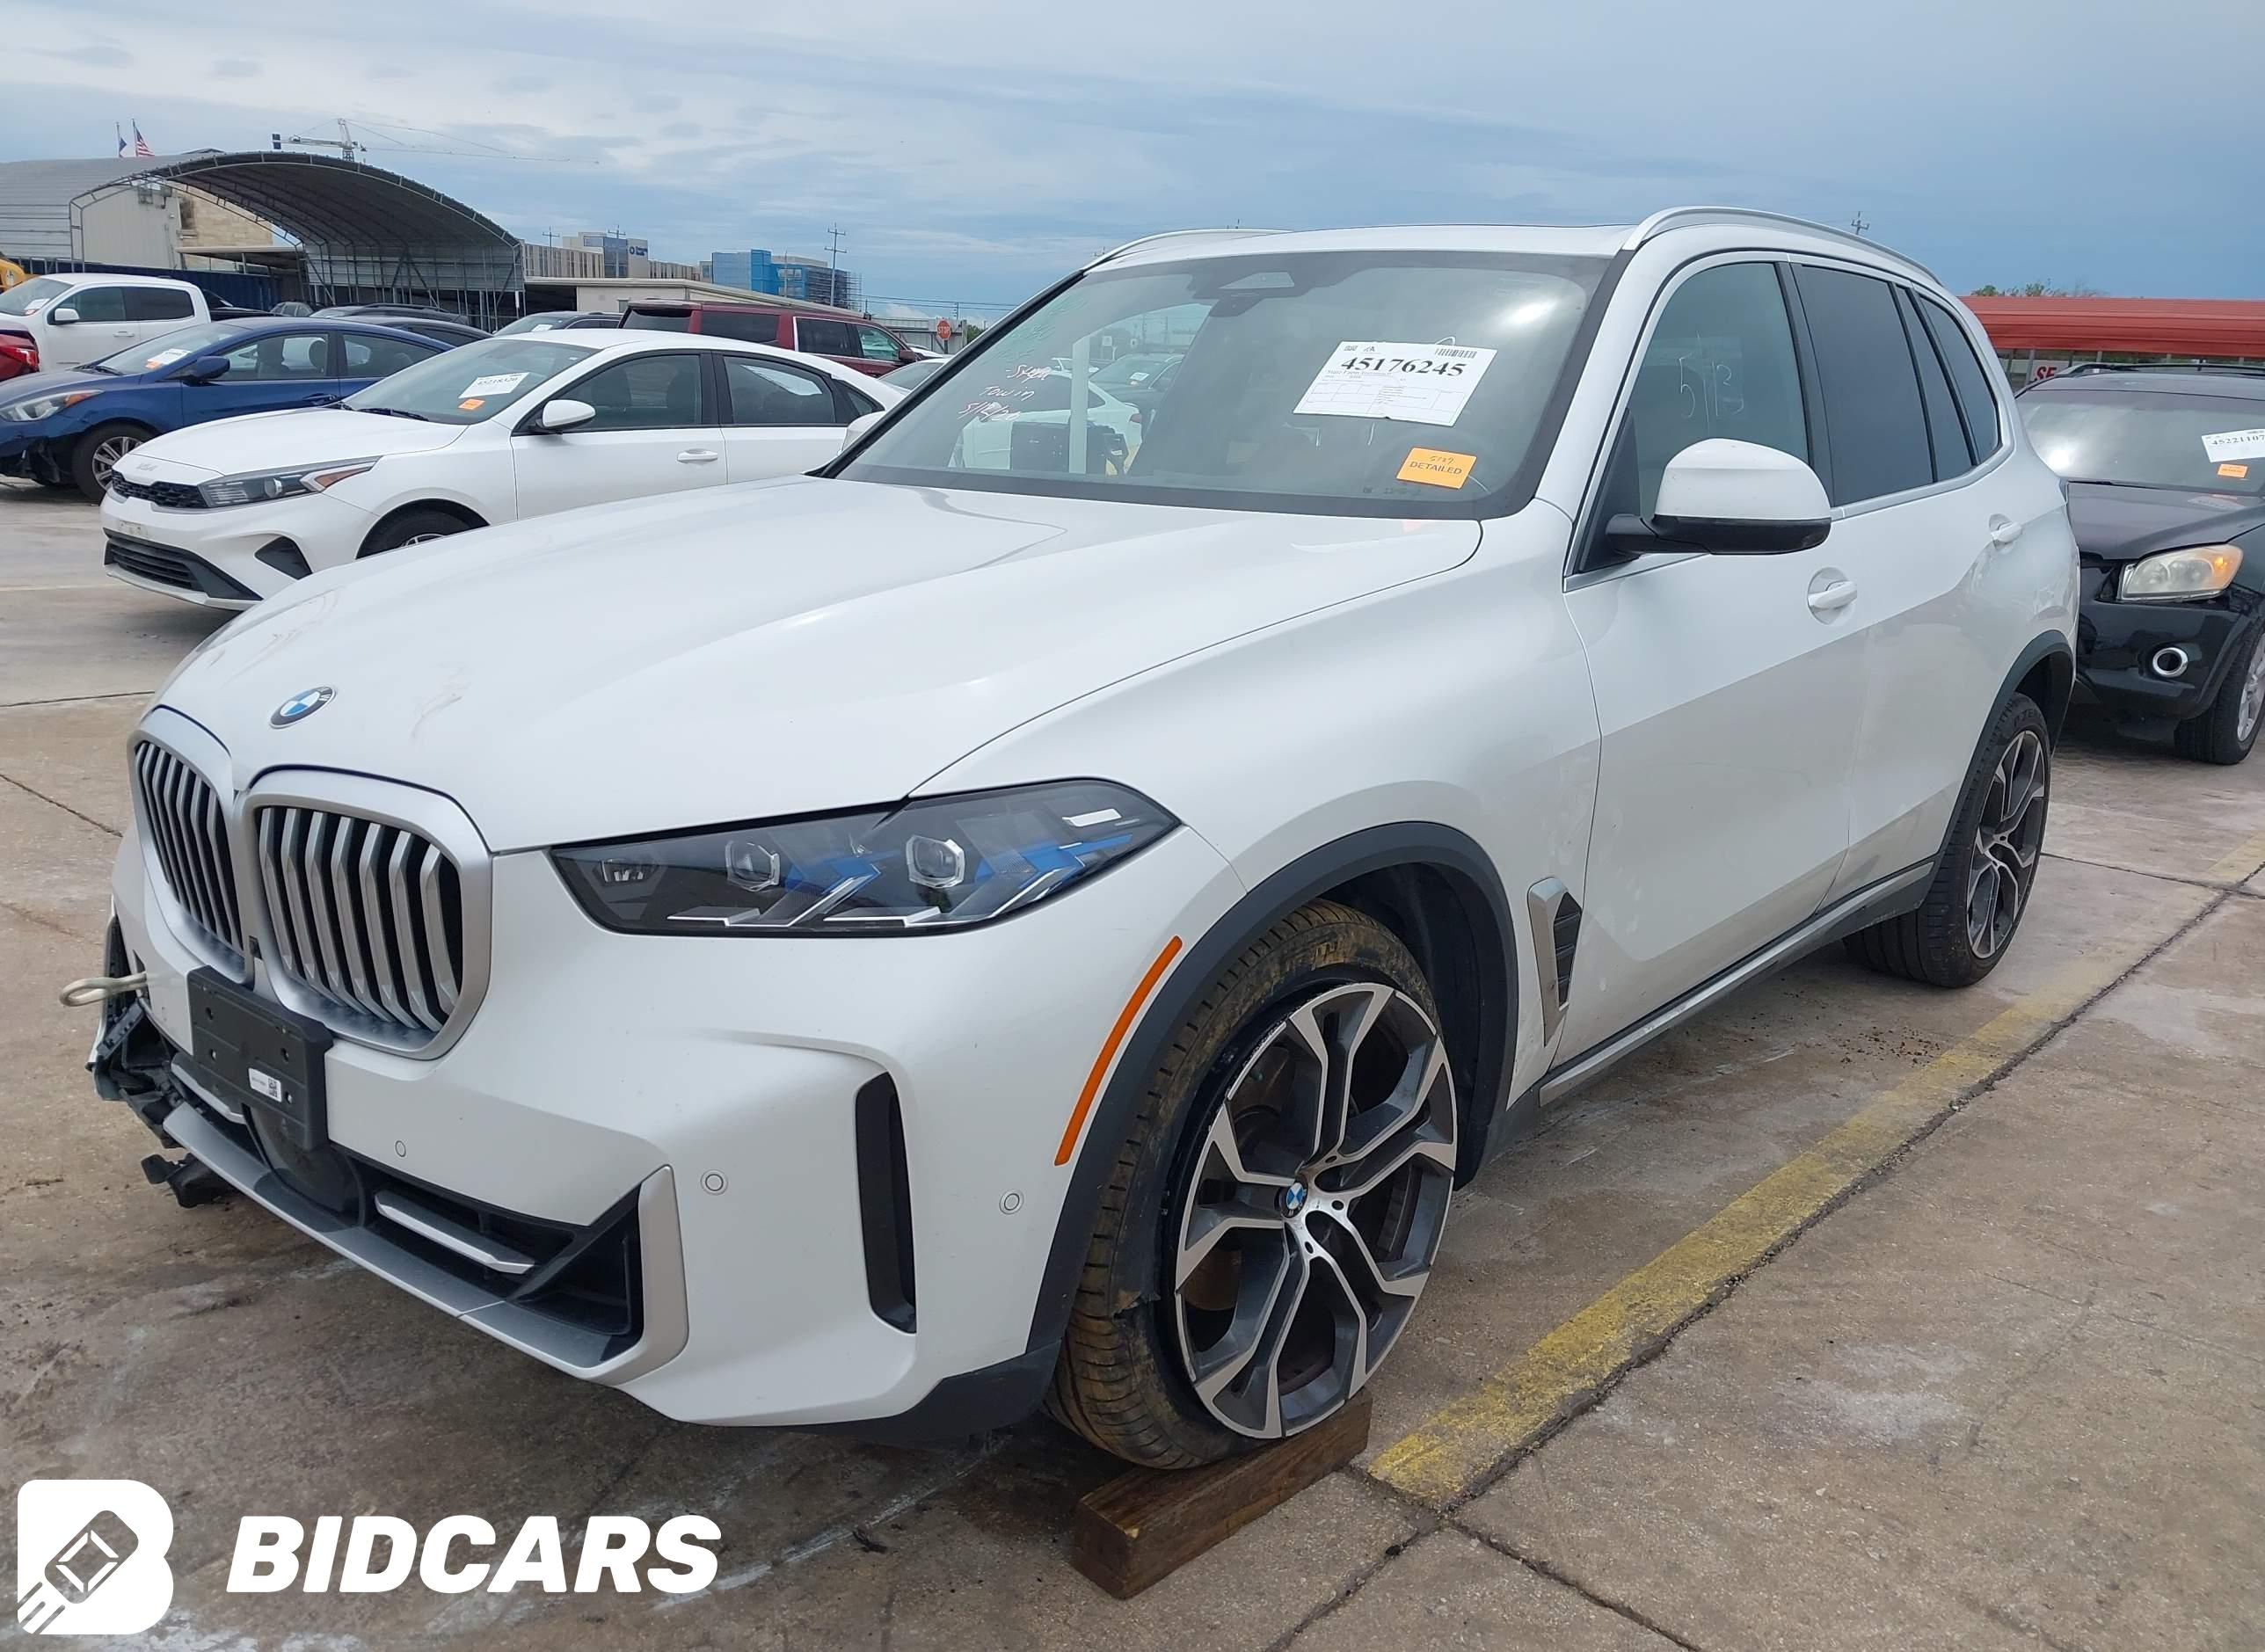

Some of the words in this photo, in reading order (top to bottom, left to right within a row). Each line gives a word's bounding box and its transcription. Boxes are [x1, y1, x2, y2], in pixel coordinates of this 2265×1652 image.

[1341, 357, 1467, 377] 45176245
[2211, 434, 2265, 445] 45221107
[1409, 461, 1462, 475] DETAILED
